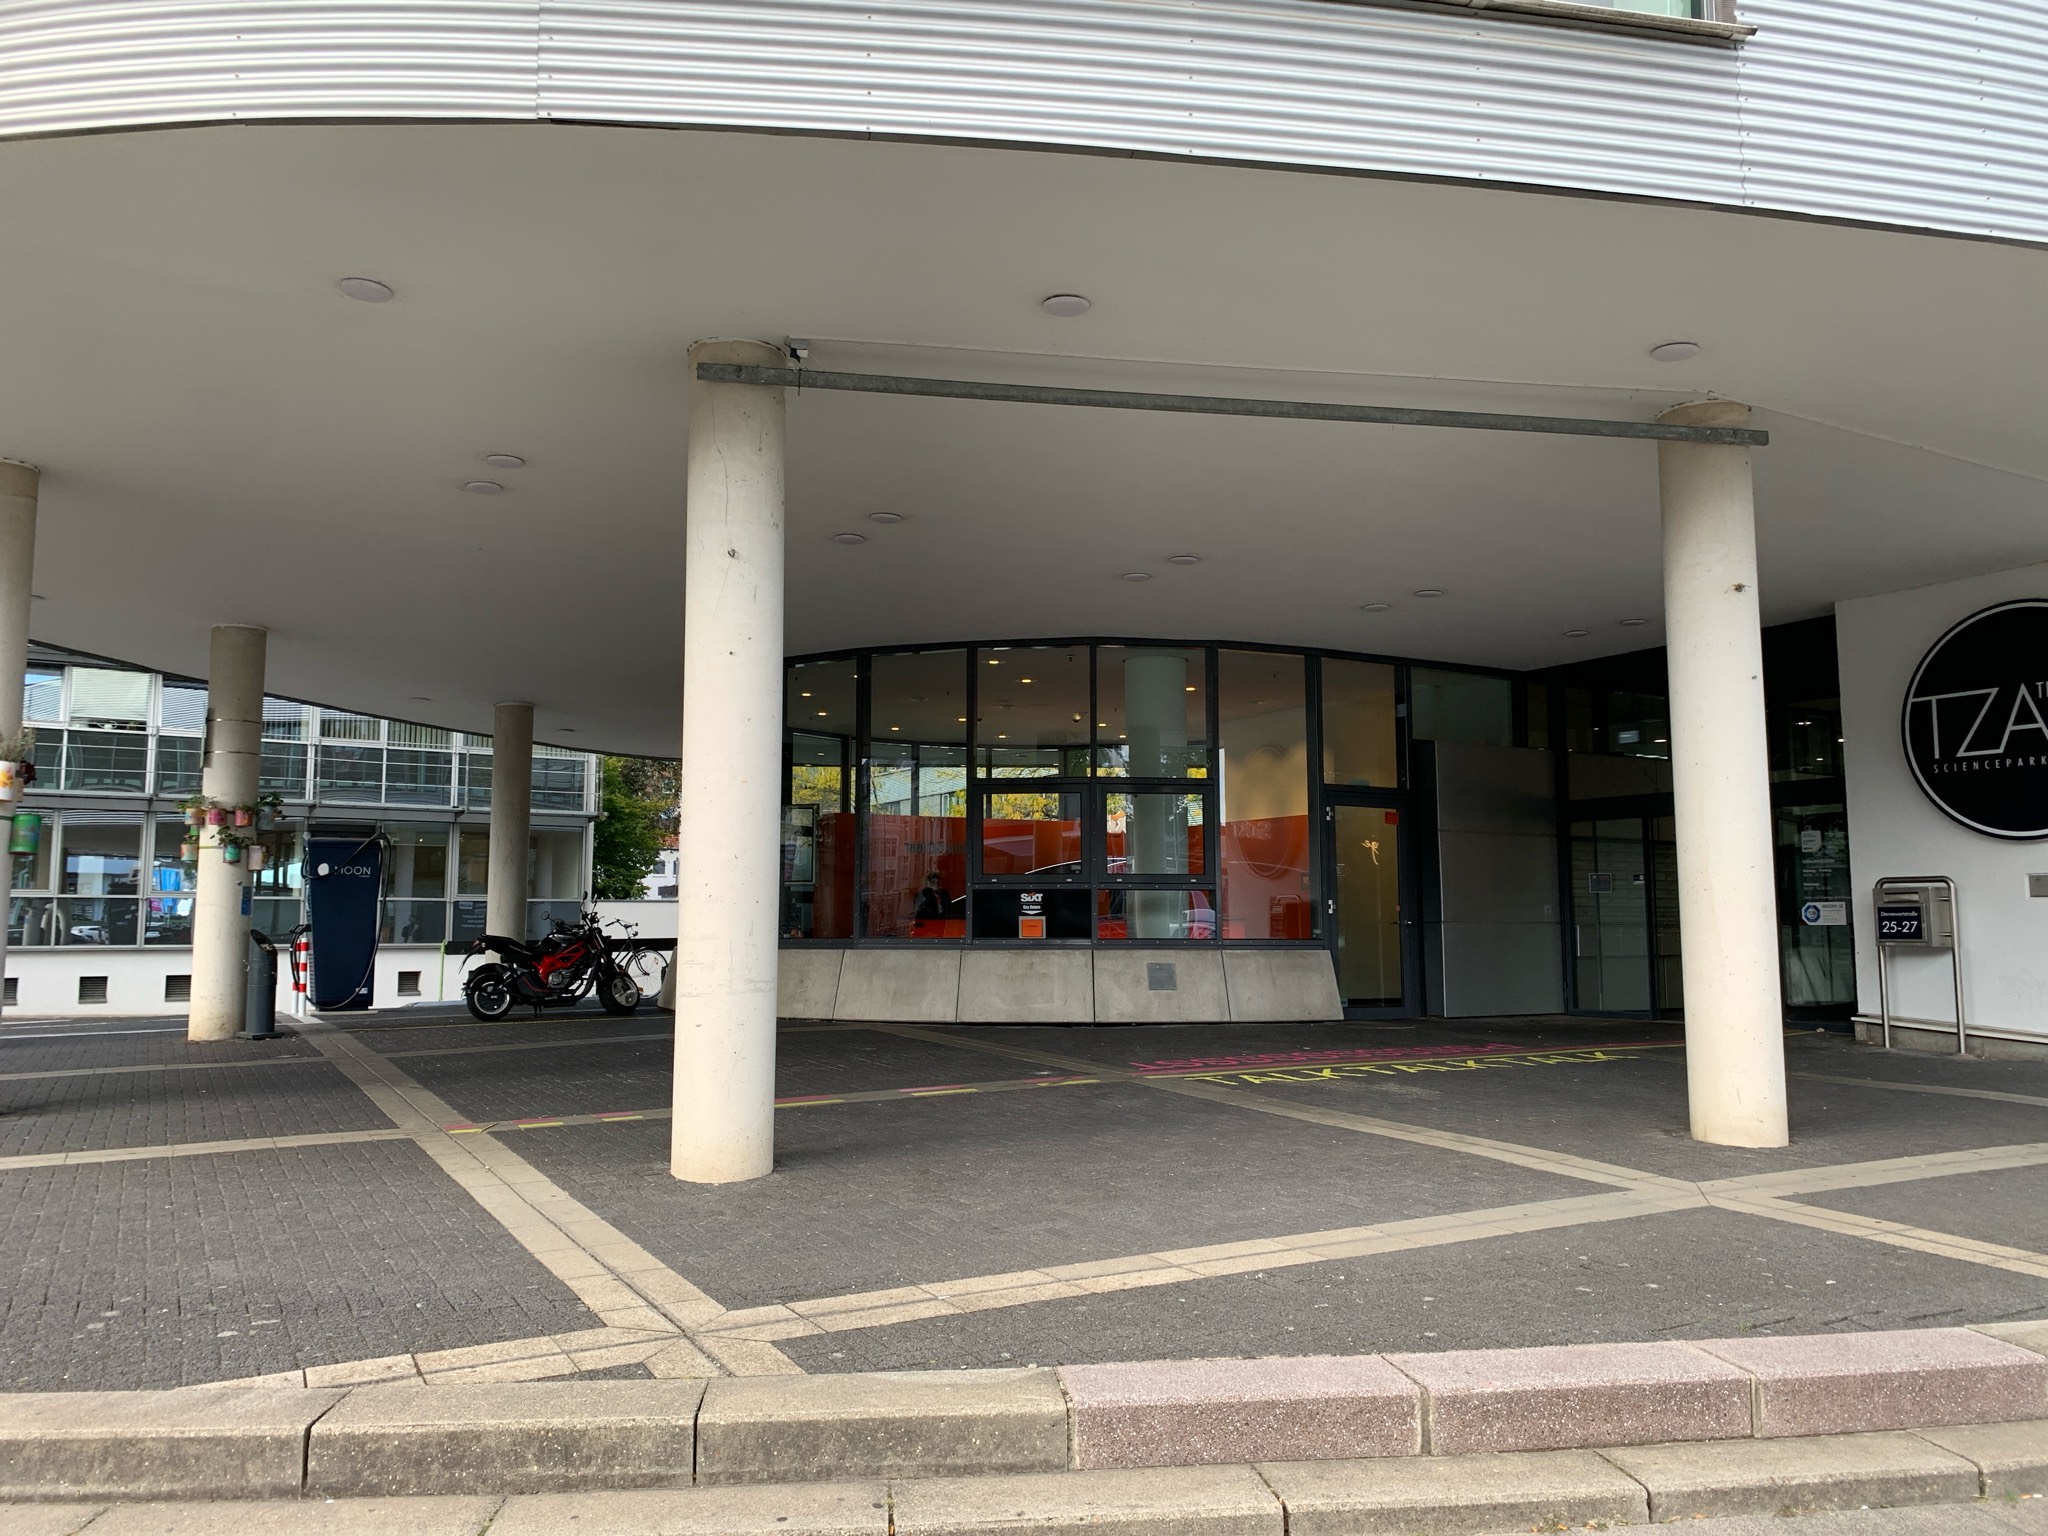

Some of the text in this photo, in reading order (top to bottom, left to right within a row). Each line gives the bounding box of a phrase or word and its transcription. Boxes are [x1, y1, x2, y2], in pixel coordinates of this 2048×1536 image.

[2035, 682, 2048, 699] T
[1911, 683, 2048, 759] TZA
[1882, 921, 1918, 933] 25-27
